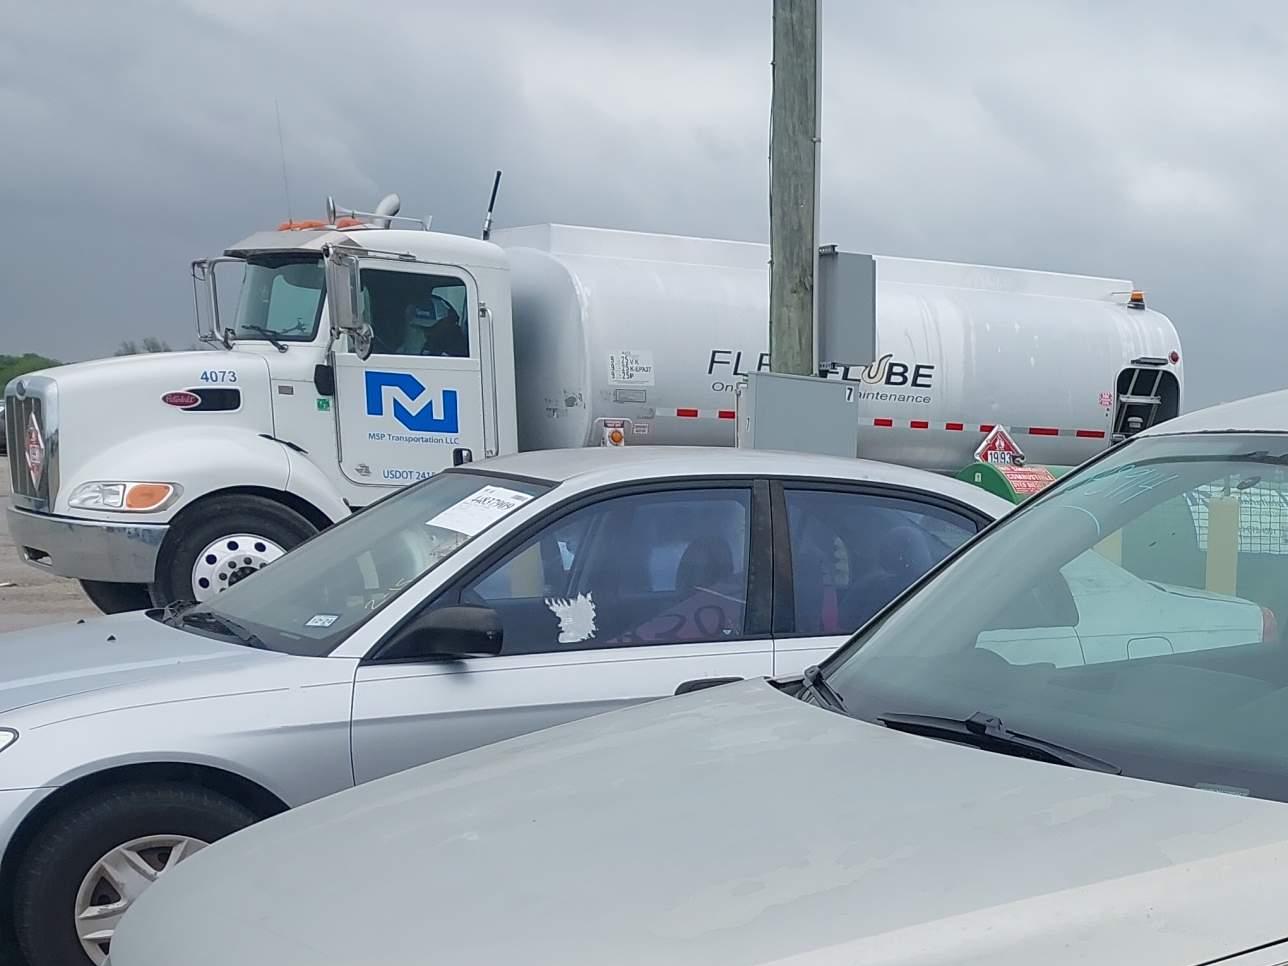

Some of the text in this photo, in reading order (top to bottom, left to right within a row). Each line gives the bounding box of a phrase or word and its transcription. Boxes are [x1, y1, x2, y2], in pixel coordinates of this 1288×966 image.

[200, 370, 237, 383] 4073
[368, 432, 460, 445] MSP Transportation LLC
[989, 452, 1012, 464] 1993
[382, 469, 414, 480] USDOT
